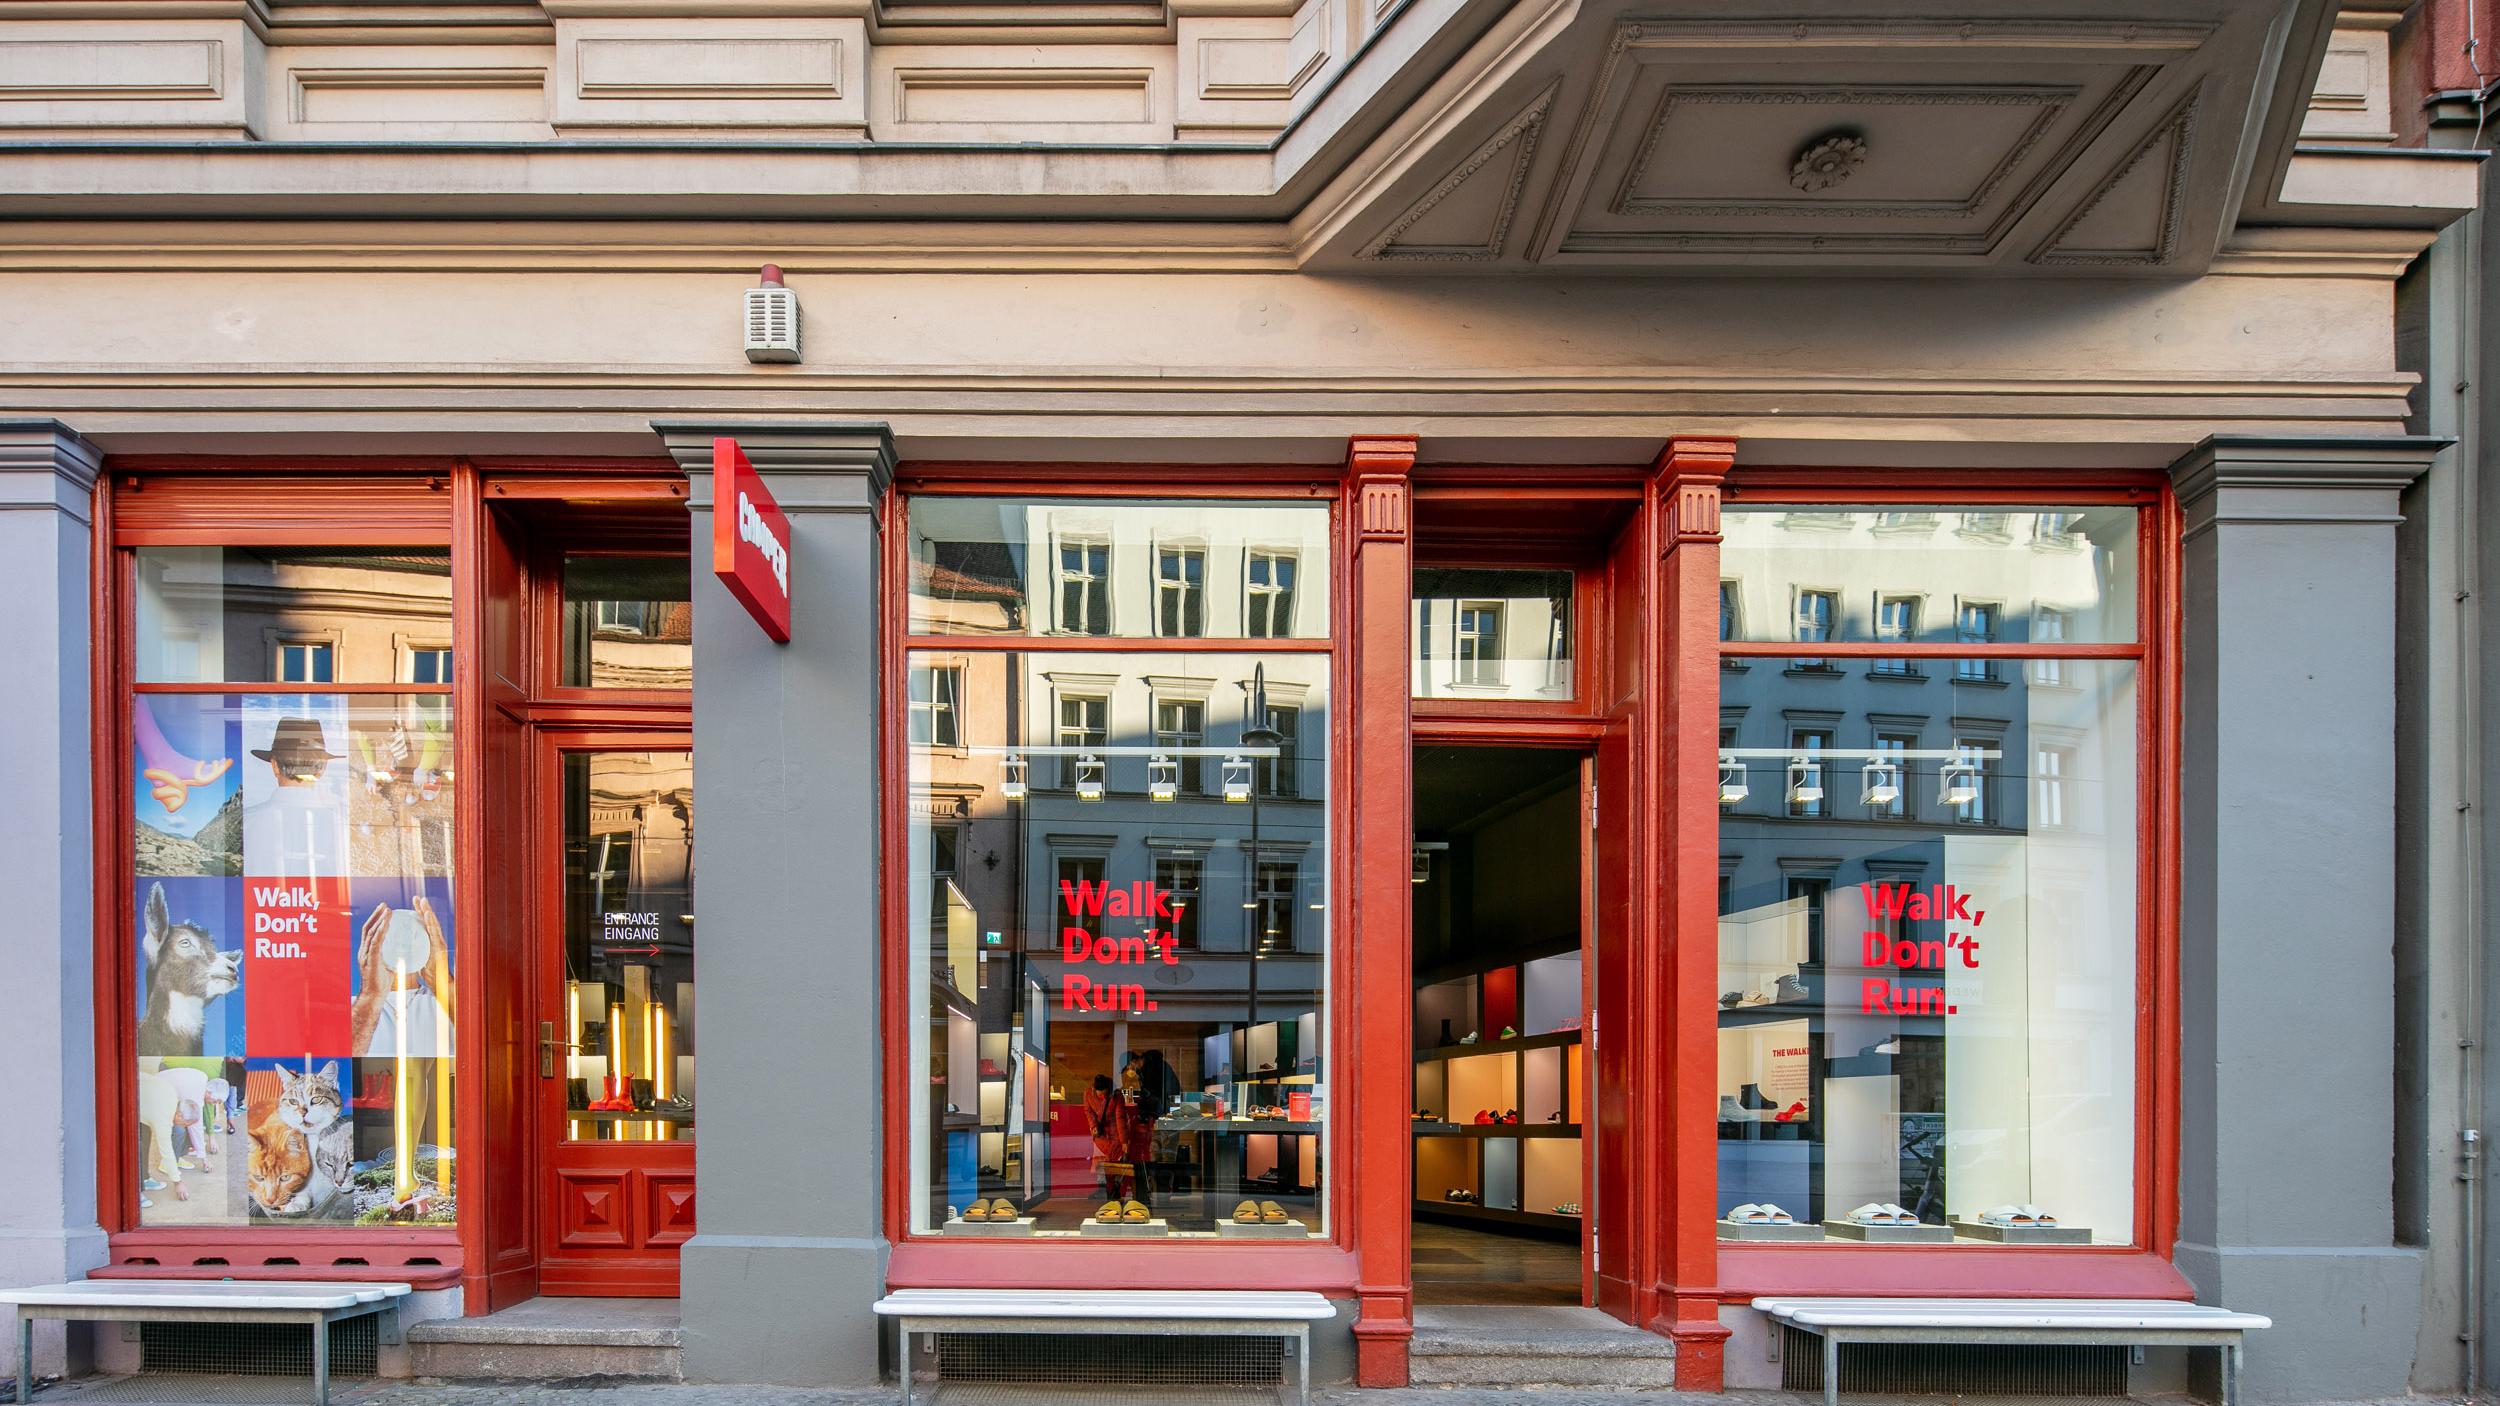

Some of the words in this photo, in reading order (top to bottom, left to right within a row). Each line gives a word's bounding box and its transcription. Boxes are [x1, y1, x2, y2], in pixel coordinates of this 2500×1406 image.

[739, 491, 787, 598] CAMPER
[253, 887, 320, 910] Walk,
[1061, 879, 1184, 923] Walk,
[1861, 882, 1985, 926] Walk,
[255, 912, 318, 933] Don’t
[604, 912, 659, 925] ENTRANCE
[604, 927, 659, 940] EINGANG
[255, 938, 307, 958] Run.
[1063, 927, 1179, 965] Don’t
[1862, 931, 1980, 968] Don’t
[1063, 974, 1158, 1011] Run.
[1862, 978, 1958, 1015] Run.
[1772, 1049, 1786, 1057] THE
